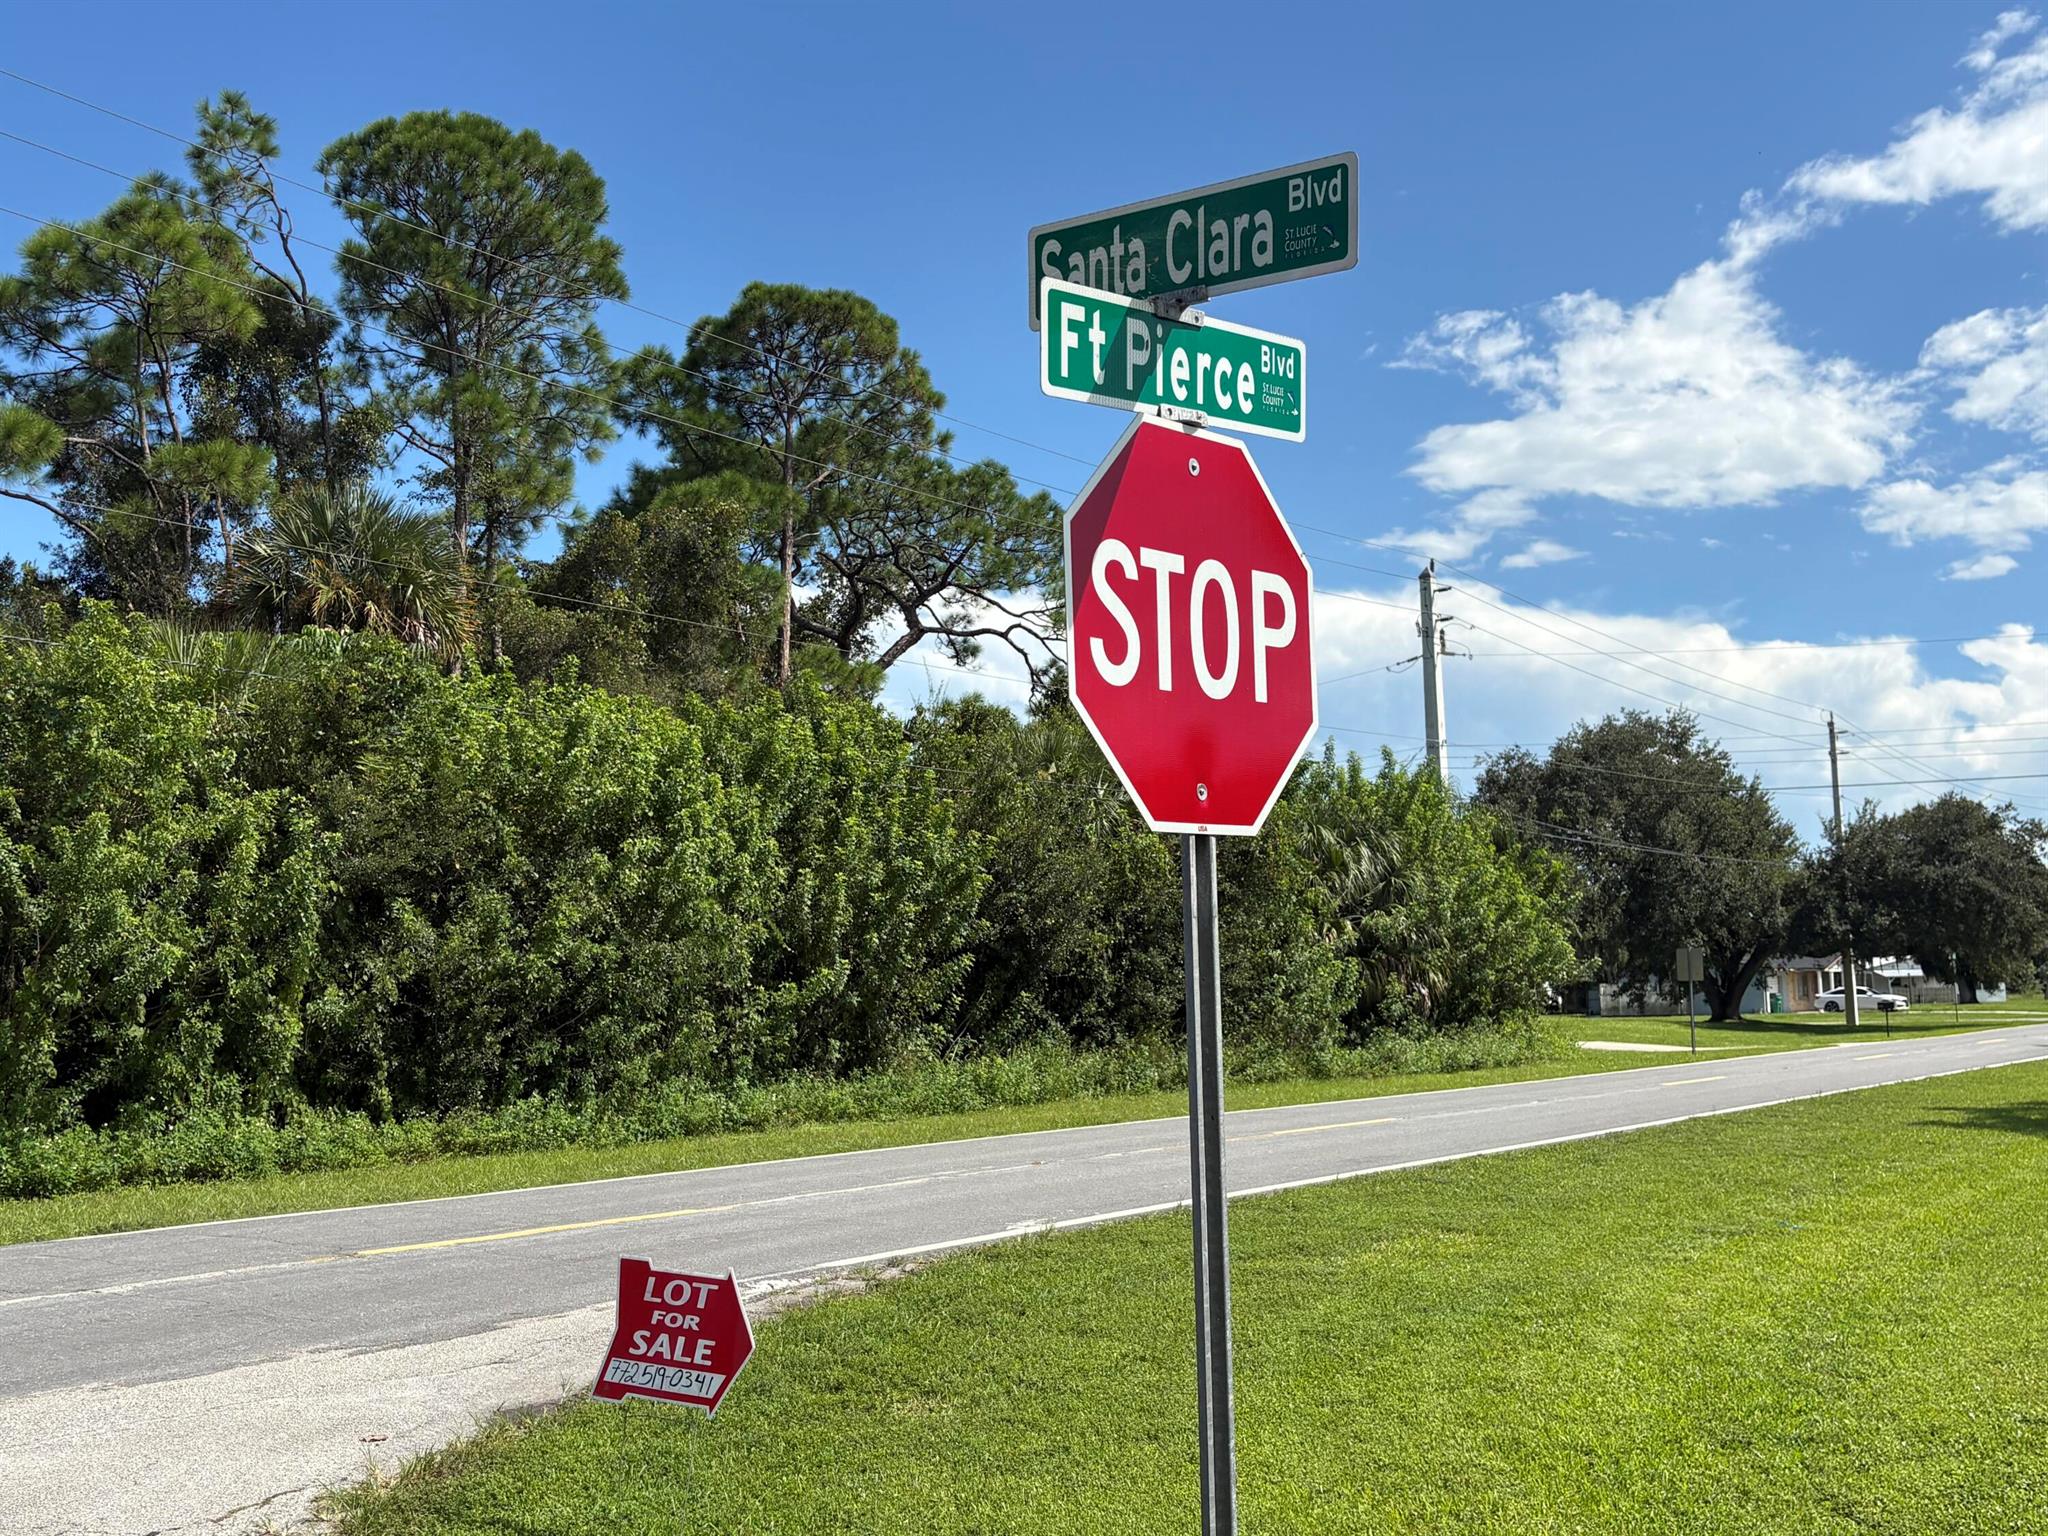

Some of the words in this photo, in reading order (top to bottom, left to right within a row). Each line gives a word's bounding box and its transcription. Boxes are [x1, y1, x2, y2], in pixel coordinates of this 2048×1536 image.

[1041, 224, 1146, 296] Santa
[1165, 204, 1274, 285] Clara
[1288, 168, 1342, 213] Blvd
[1284, 236, 1317, 252] COUNTY
[1296, 224, 1317, 238] LUCIE
[1060, 301, 1106, 386] Ft
[1126, 316, 1256, 415] Pierce
[1261, 344, 1295, 380] Blvd
[1262, 393, 1284, 407] COUNTY
[1089, 537, 1298, 704] STOP
[643, 1276, 719, 1309] LOT
[651, 1310, 700, 1331] FOR
[628, 1329, 716, 1366] SALE
